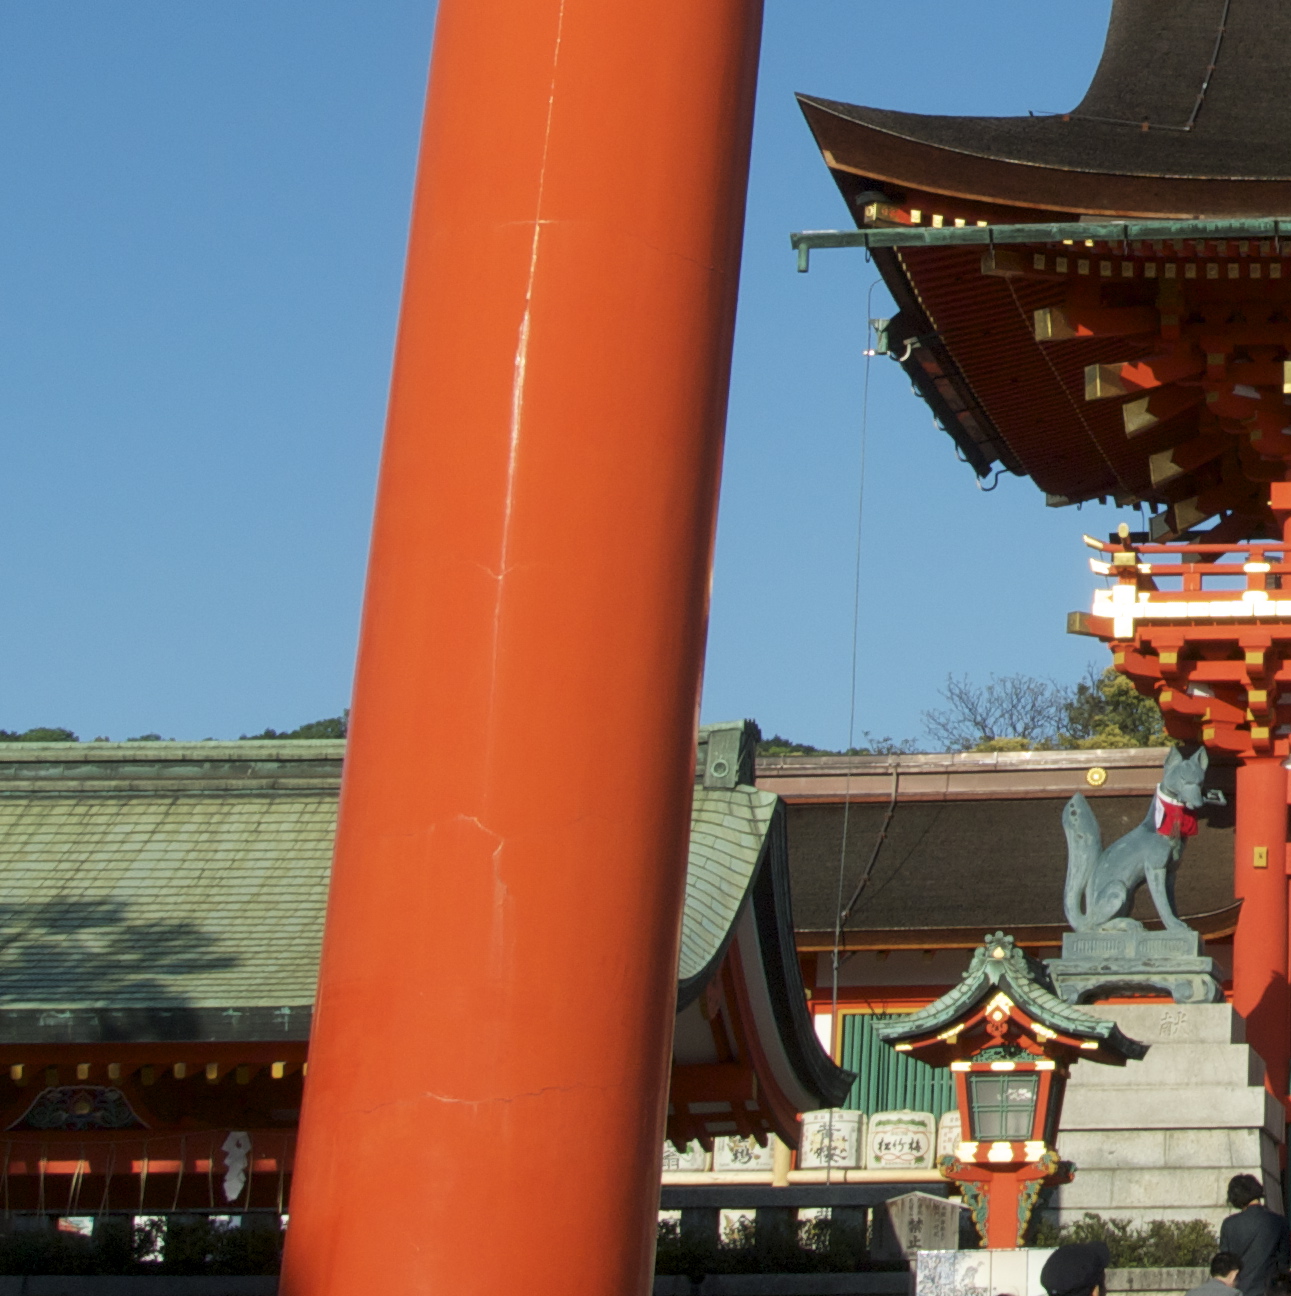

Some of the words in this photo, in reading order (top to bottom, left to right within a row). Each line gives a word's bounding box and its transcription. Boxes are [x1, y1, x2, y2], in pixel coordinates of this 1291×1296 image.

[876, 1136, 923, 1153] 松竹梅
[906, 1216, 924, 1250] 禁止
